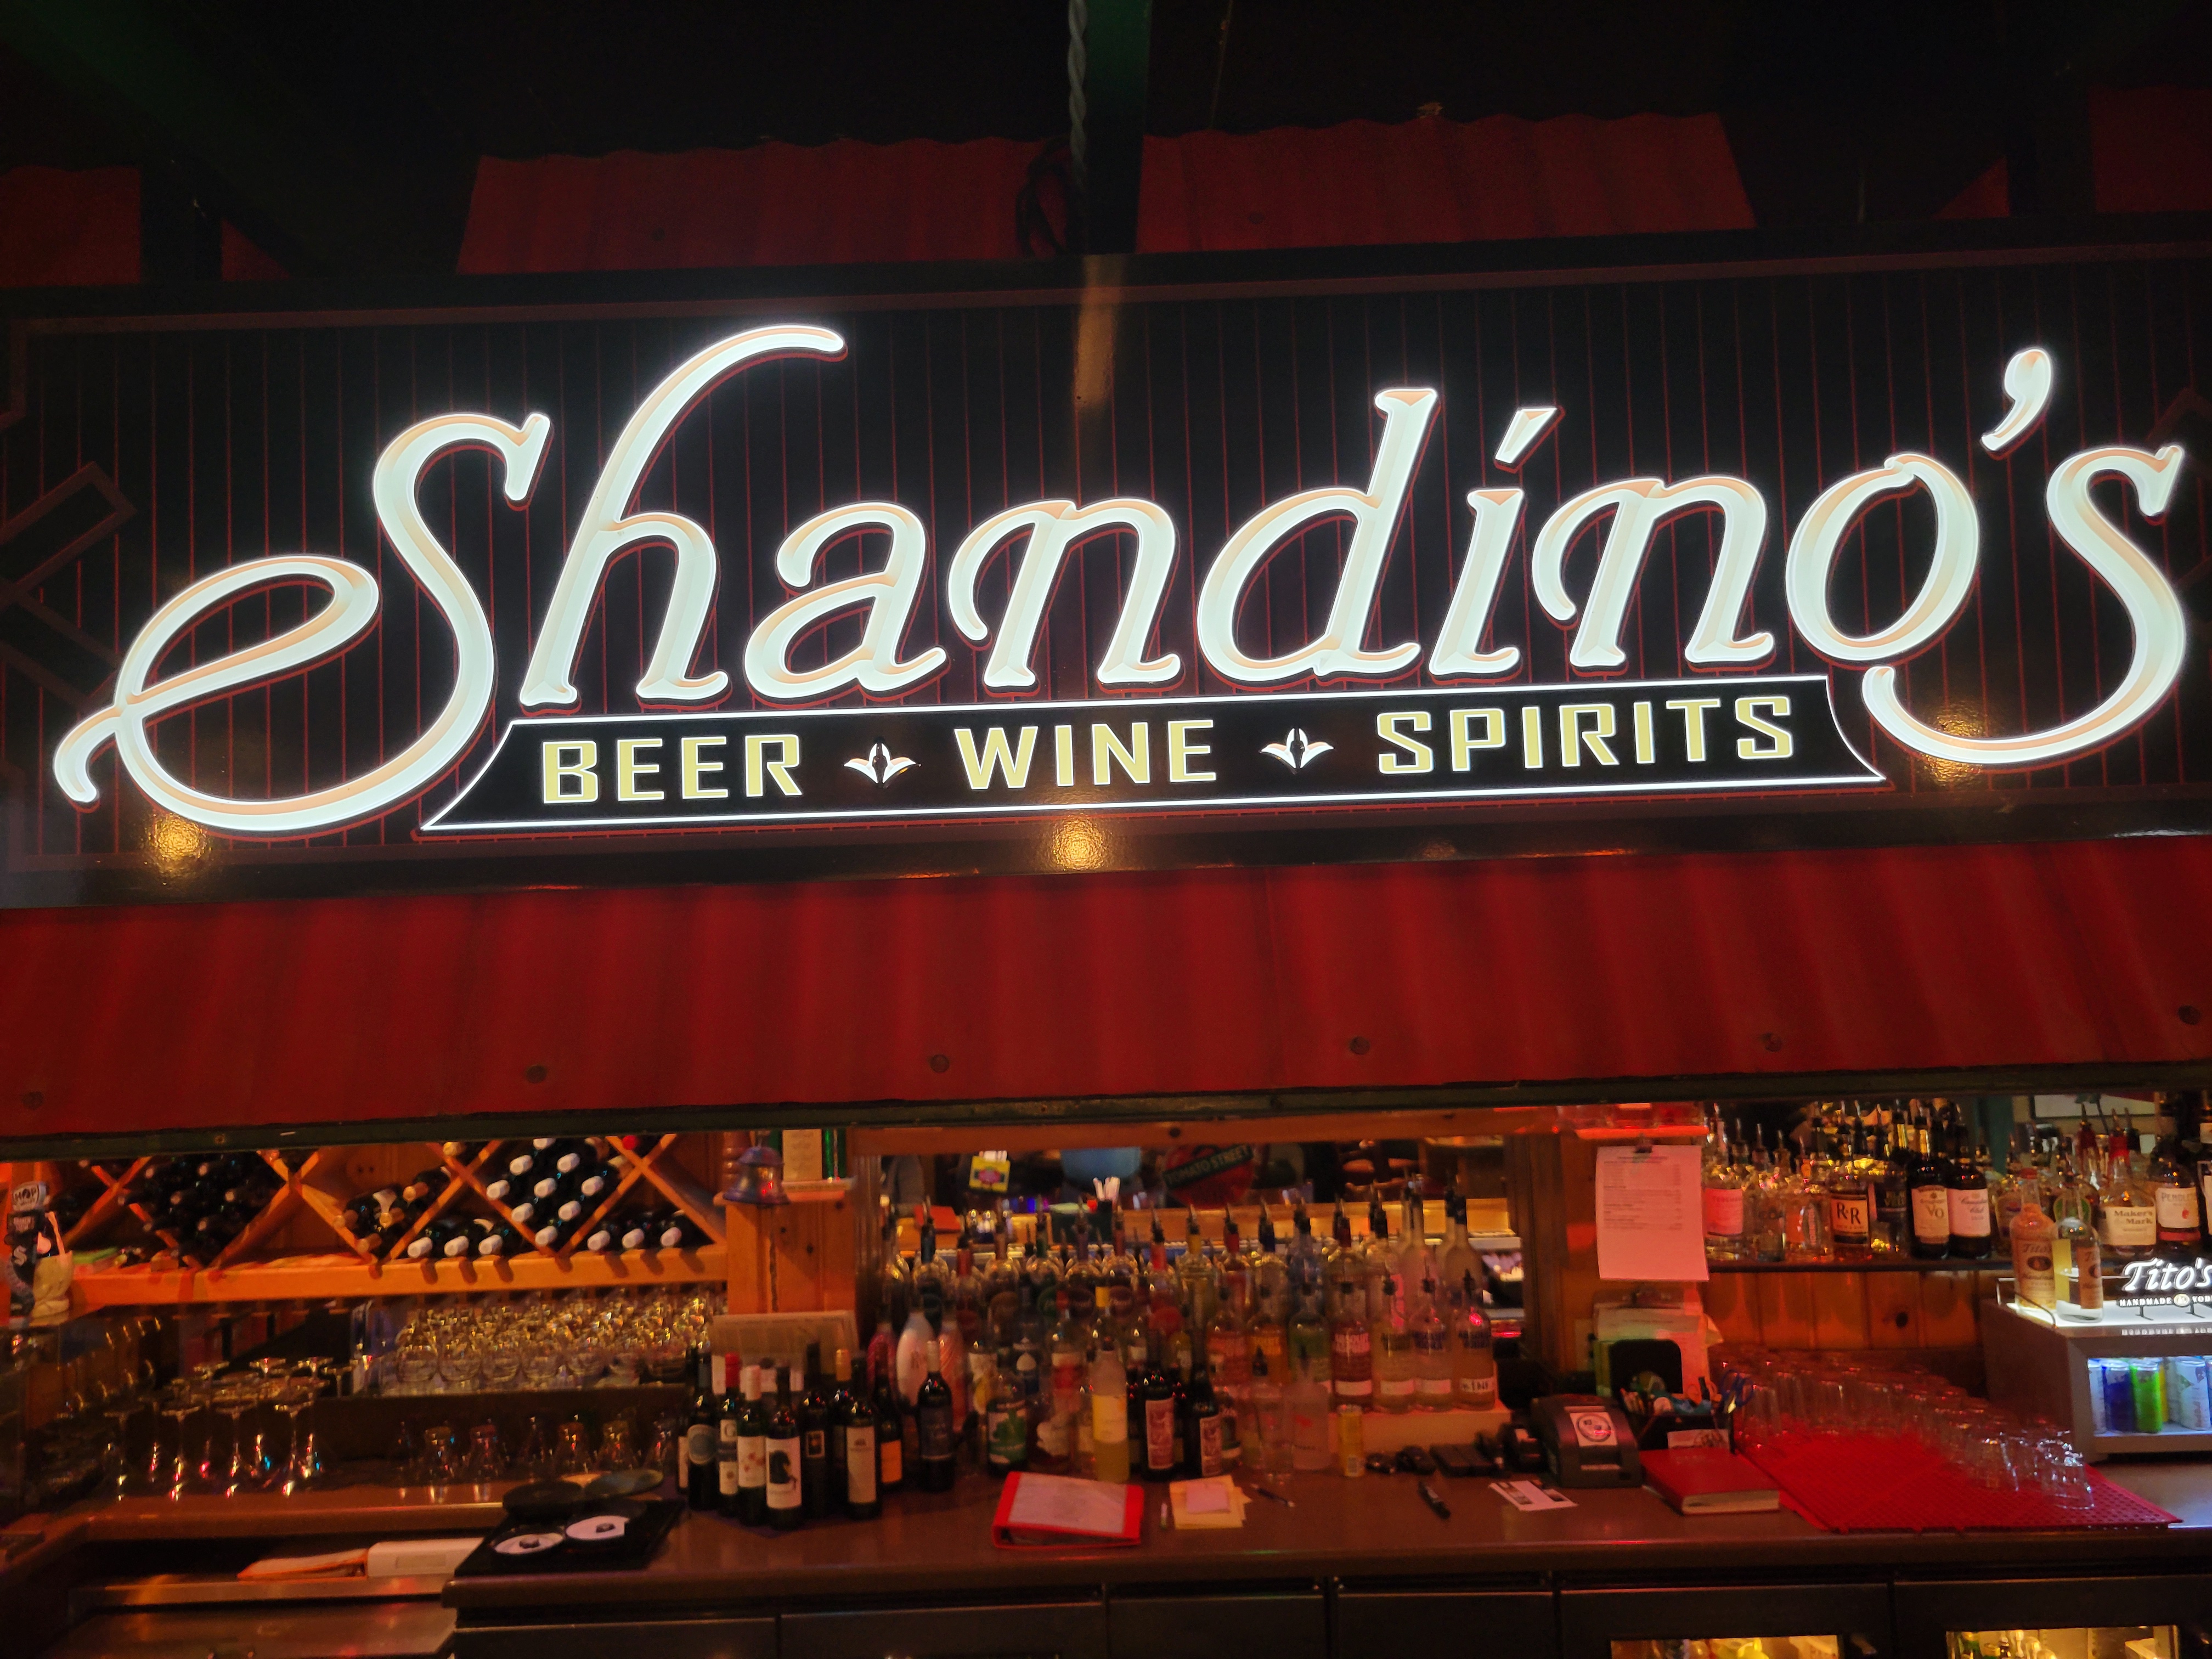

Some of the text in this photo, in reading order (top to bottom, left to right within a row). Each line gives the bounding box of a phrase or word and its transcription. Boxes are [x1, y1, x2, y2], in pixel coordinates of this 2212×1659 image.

[53, 323, 2189, 837] Shandino's
[541, 696, 1793, 804] BEER WINE SPIRITS
[2120, 1298, 2172, 1307] HANDMADE
[2123, 1257, 2212, 1291] Tito's
